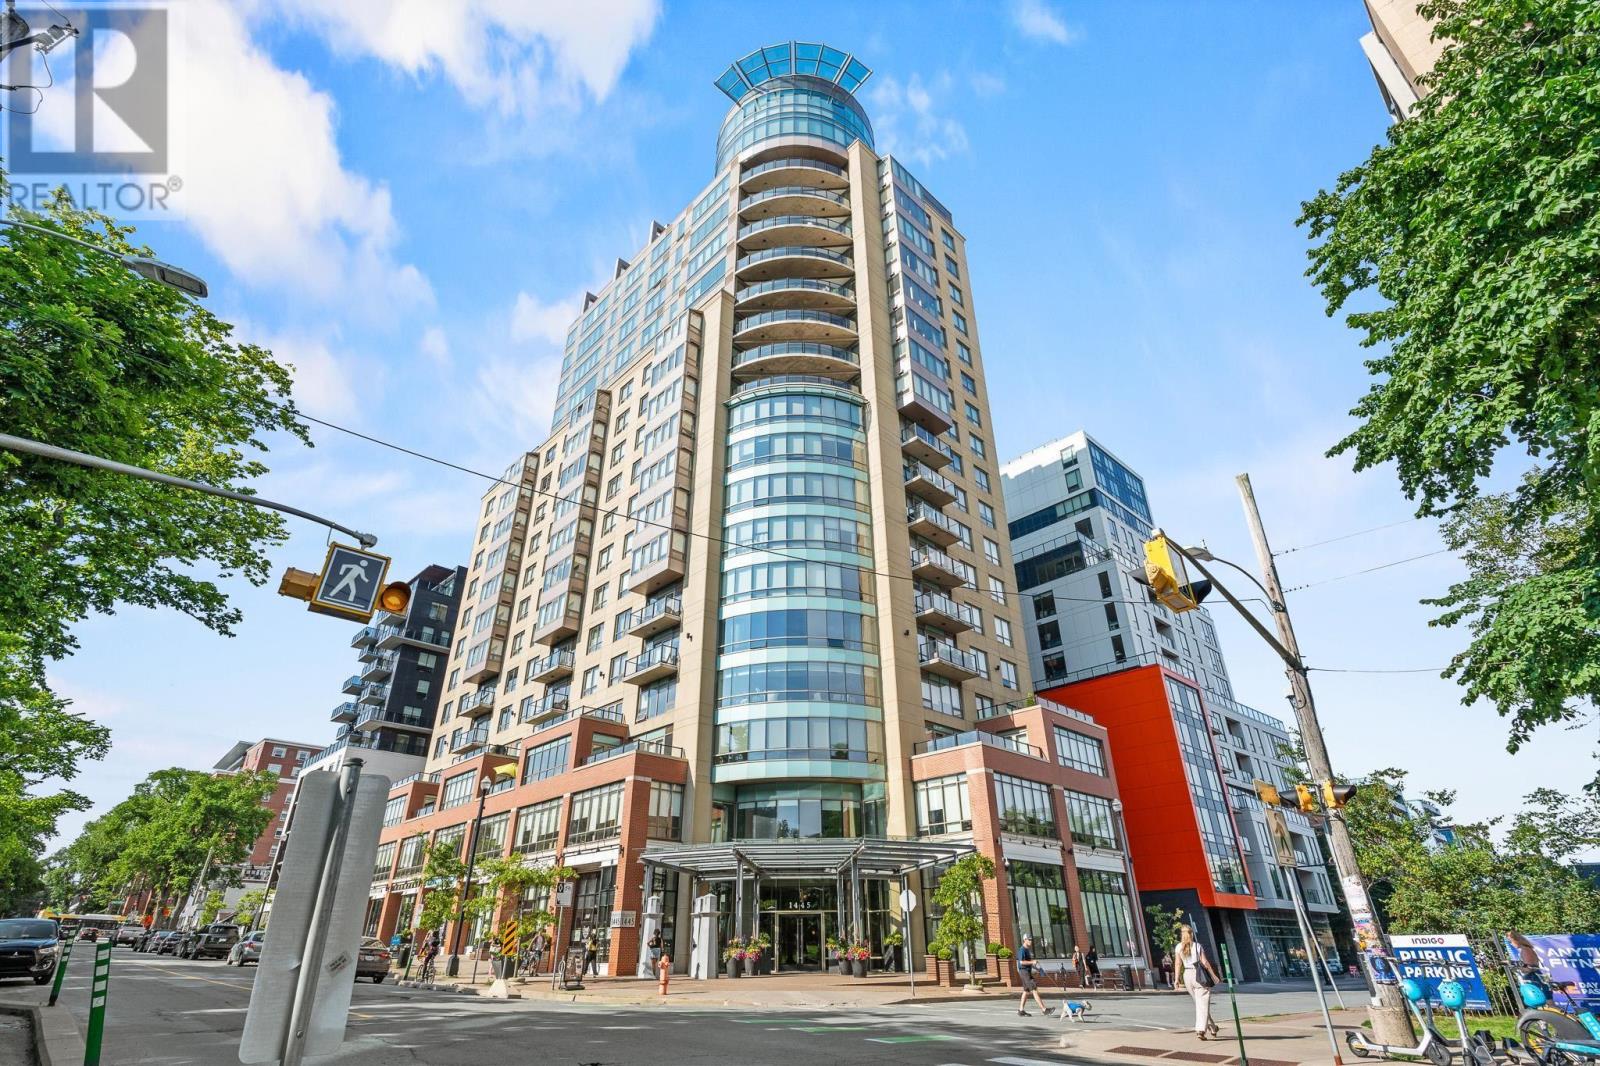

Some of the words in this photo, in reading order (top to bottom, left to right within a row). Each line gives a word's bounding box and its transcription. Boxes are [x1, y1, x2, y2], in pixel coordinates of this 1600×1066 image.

[789, 901, 811, 909] 1445
[621, 917, 635, 926] 1445
[1547, 947, 1600, 957] ANYTI
[1404, 966, 1475, 978] PARKING
[1578, 981, 1598, 989] DAY
